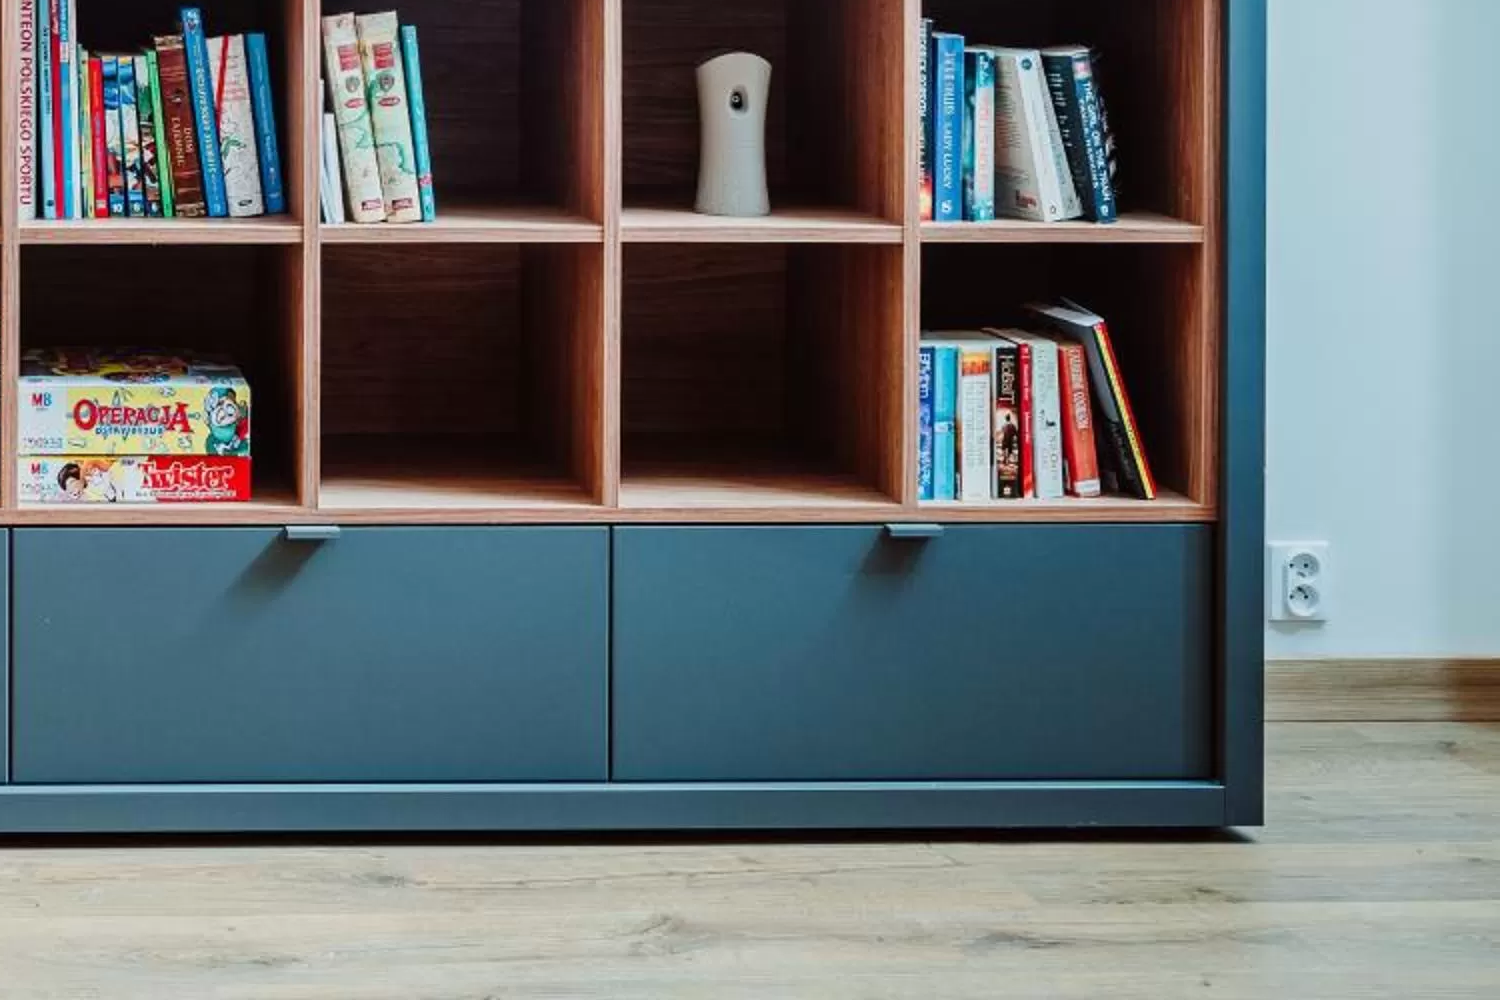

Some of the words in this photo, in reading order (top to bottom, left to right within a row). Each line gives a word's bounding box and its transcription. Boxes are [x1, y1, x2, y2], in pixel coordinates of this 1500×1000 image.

[20, 56, 32, 135] POLSKIEGO
[19, 140, 32, 205] SPORTU
[31, 391, 52, 406] MB
[73, 398, 194, 433] OPERACJA
[138, 461, 235, 489] Twister
